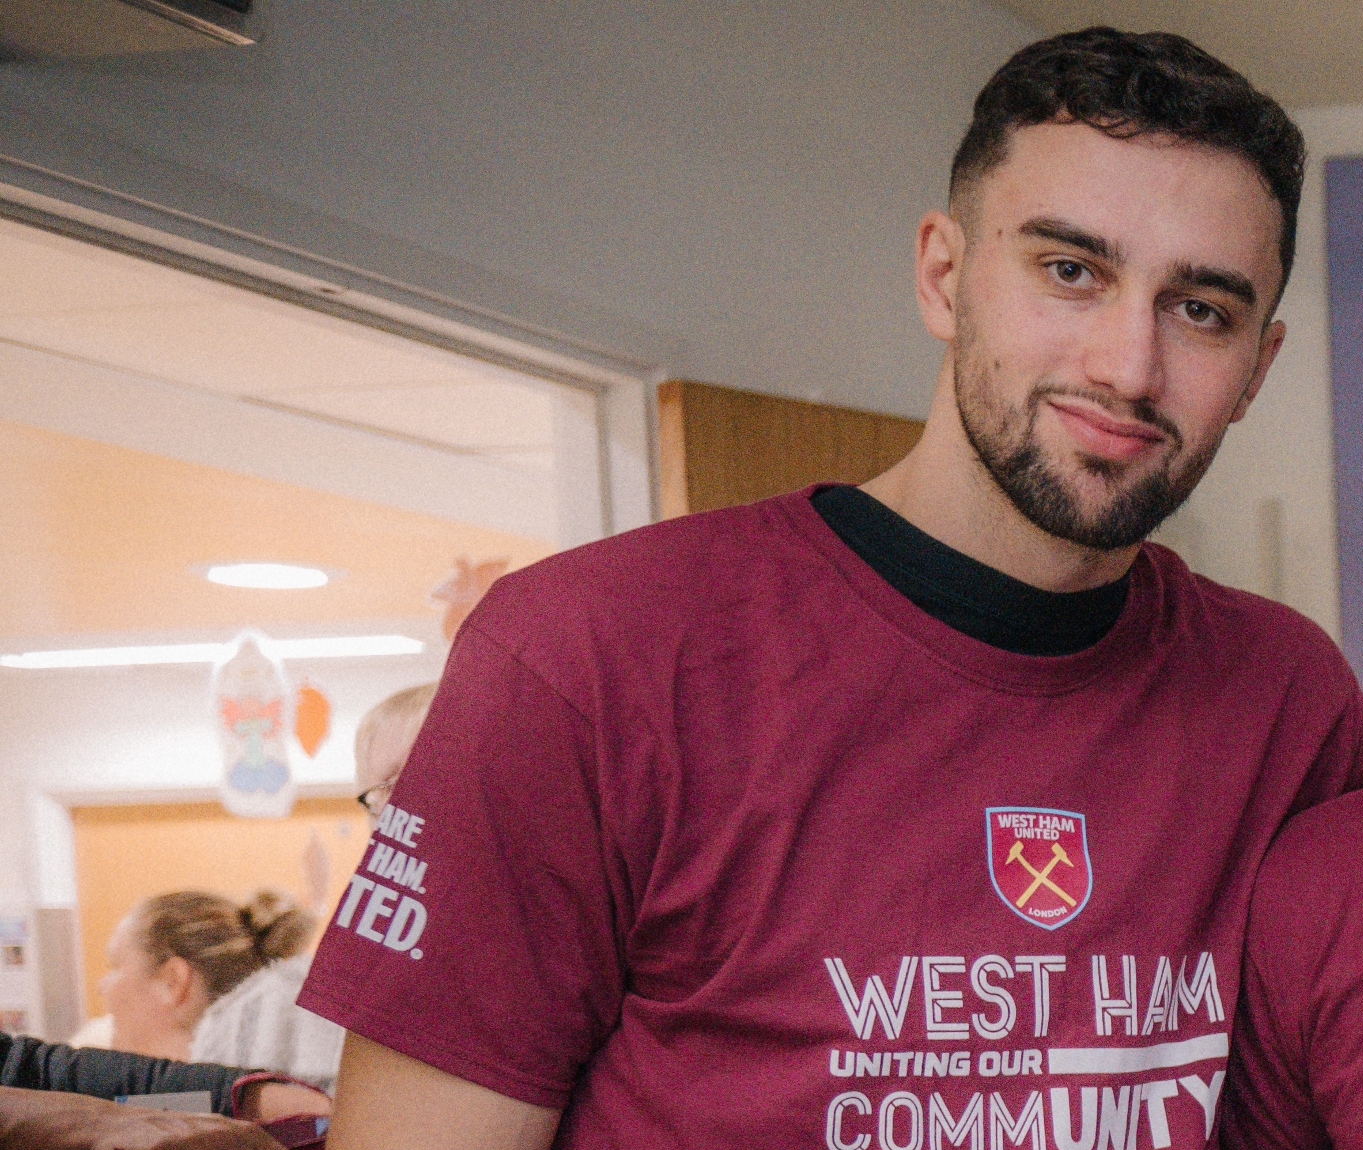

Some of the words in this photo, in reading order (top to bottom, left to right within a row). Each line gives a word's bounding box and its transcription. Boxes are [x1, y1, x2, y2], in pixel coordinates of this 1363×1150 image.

[375, 803, 426, 849] ARE
[998, 814, 1037, 829] WEST
[1040, 815, 1076, 833] HAM
[1014, 828, 1060, 840] UNITED
[1028, 905, 1068, 918] LONDON
[823, 954, 1067, 1041] WEST
[1091, 951, 1226, 1037] HAM
[829, 1049, 971, 1078] UNITING
[978, 1048, 1043, 1077] OUR
